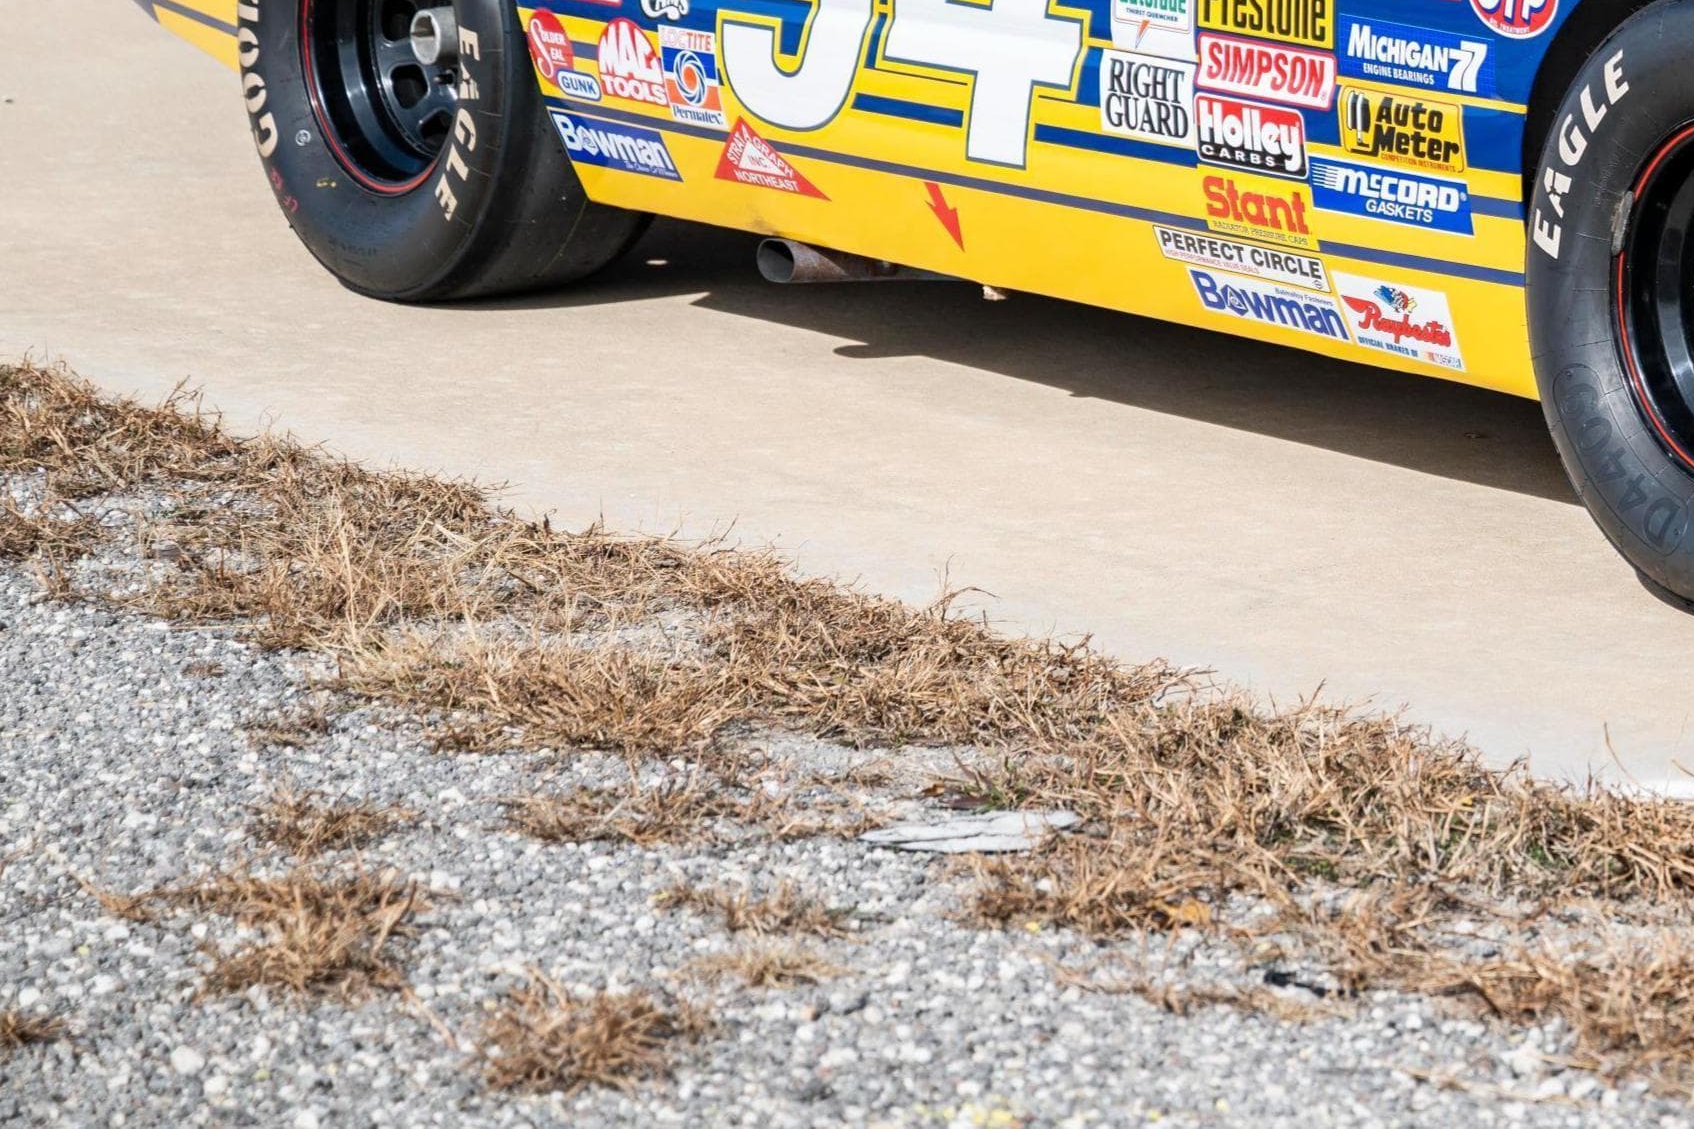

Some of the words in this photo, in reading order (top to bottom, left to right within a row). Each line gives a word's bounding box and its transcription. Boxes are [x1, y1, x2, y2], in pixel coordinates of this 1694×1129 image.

[1126, 7, 1145, 16] THIRST
[1146, 11, 1178, 22] QUENCHER
[599, 21, 664, 83] MAC
[662, 28, 712, 51] LOCTITE
[1347, 23, 1450, 72] MICHIGAN
[1447, 40, 1488, 92] 77
[561, 75, 596, 95] GUNK
[601, 74, 668, 106] TOOLS
[1109, 58, 1184, 104] RIGHT
[1207, 42, 1325, 105] SIMPSON
[1363, 62, 1391, 76] ENGINE
[1393, 67, 1434, 85] BEARINGS
[435, 25, 480, 222] EAGLE
[673, 103, 719, 124] Permatex
[1105, 93, 1188, 139] GUARD
[1200, 96, 1300, 172] Holley
[1375, 96, 1444, 133] Auto
[551, 113, 673, 170] Bowman
[1202, 145, 1276, 167] CARBS
[1362, 124, 1460, 163] Meter
[1534, 49, 1630, 261] EAGLE
[733, 169, 800, 192] NORTHEAST
[1203, 175, 1309, 235] Stant
[1366, 200, 1433, 223] GASKETS
[1160, 230, 1245, 262] PERFECT
[1251, 249, 1322, 280] CIRCLE
[1214, 221, 1249, 235] RADIATOR
[1251, 228, 1287, 242] PRESSURE
[1289, 235, 1308, 246] CAPS
[1190, 269, 1349, 340] Bowman
[1355, 303, 1451, 348] Raybestos
